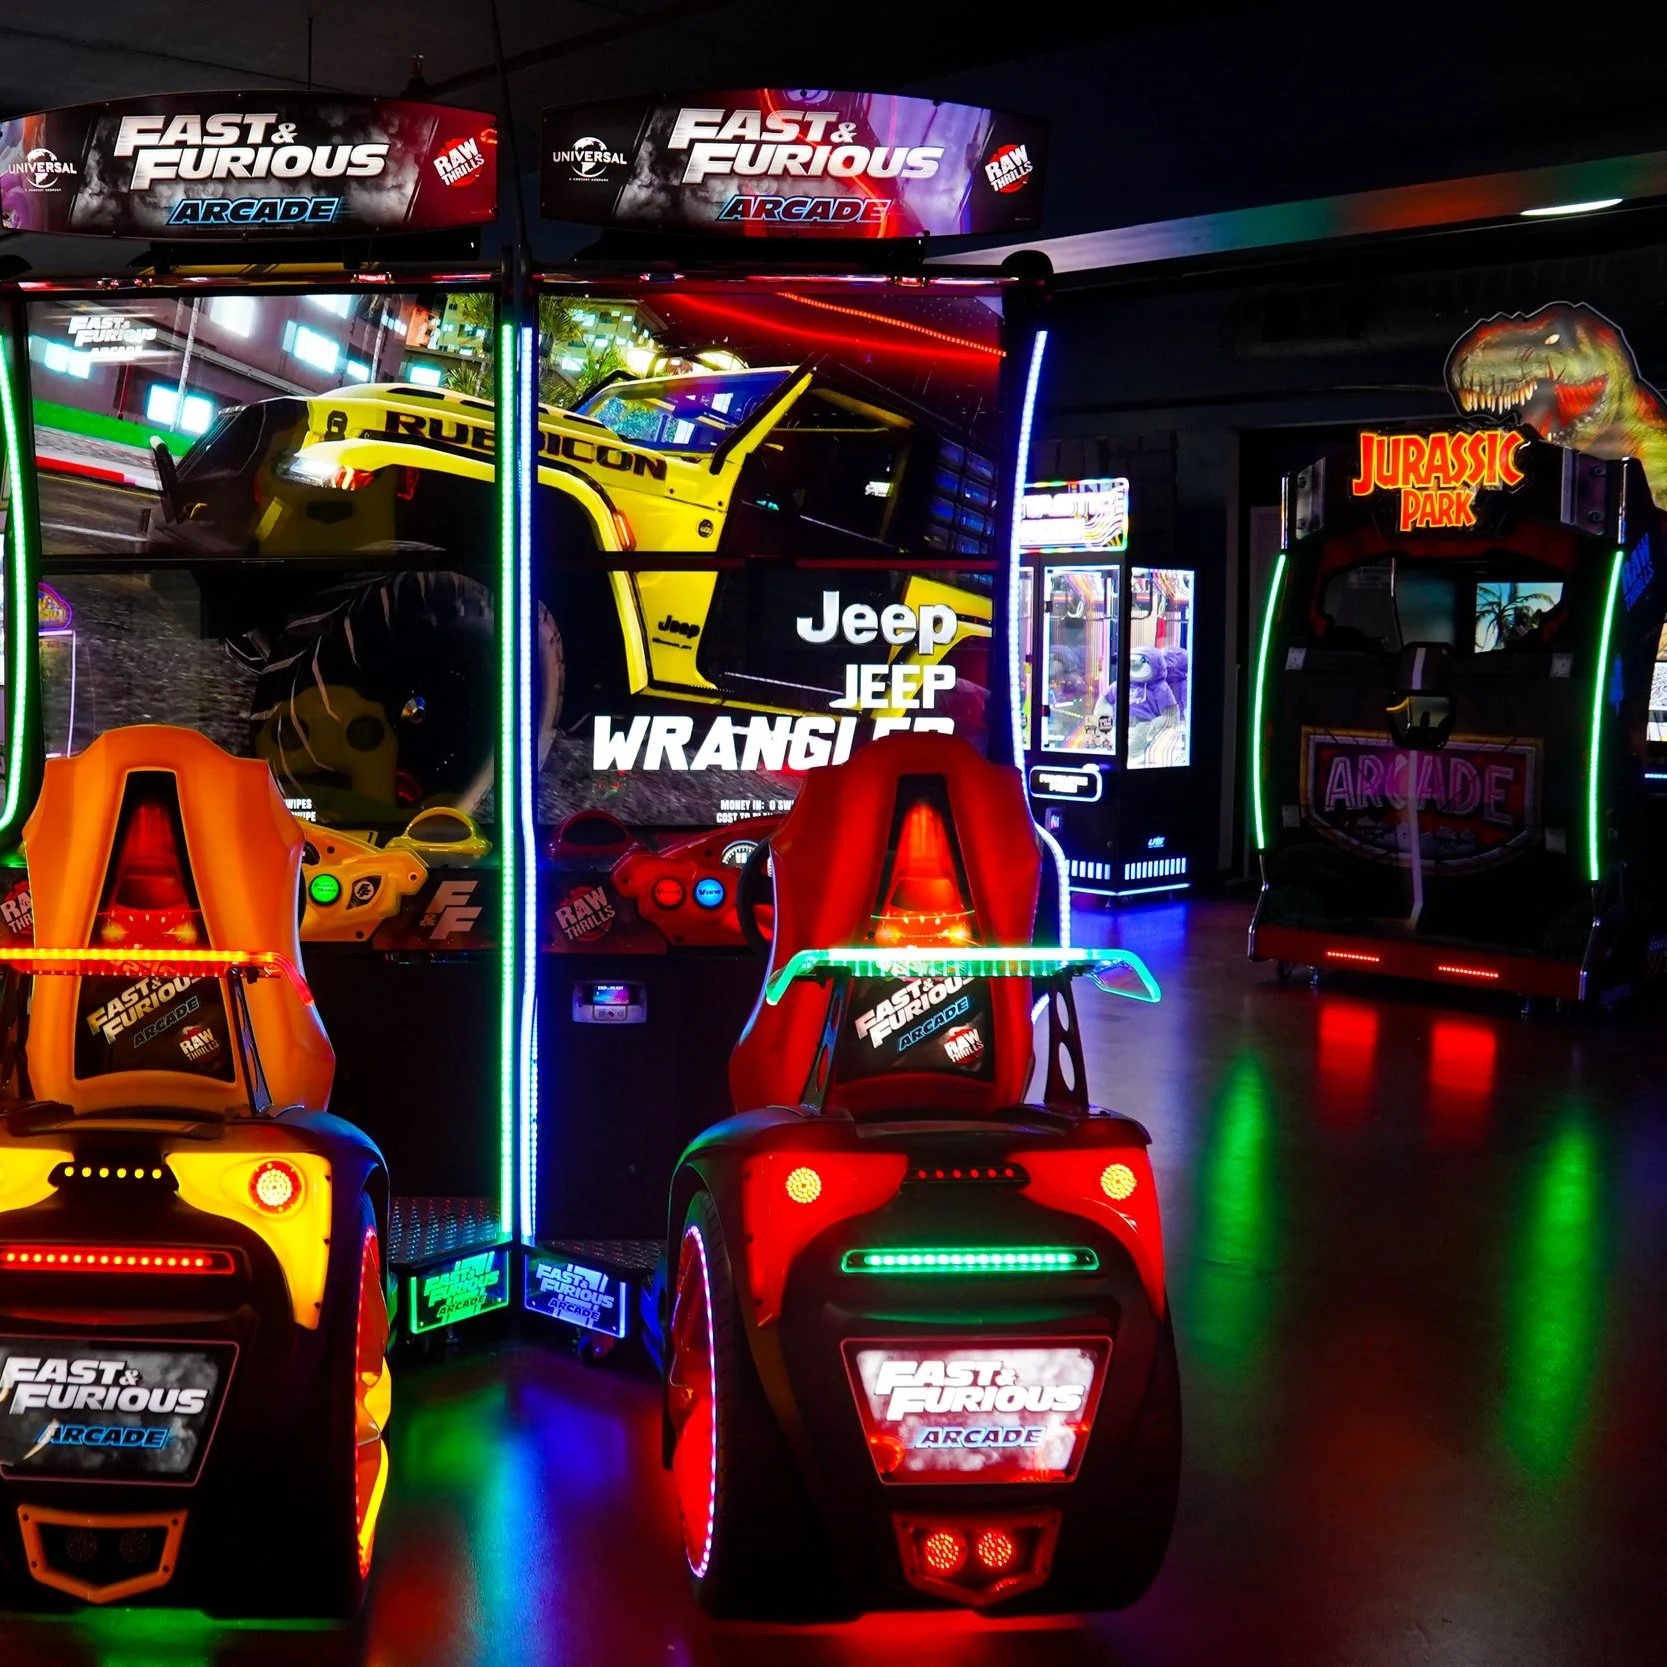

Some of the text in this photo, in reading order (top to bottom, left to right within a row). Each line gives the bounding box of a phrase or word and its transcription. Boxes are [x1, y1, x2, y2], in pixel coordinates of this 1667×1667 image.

[114, 114, 278, 157] FAST
[667, 108, 838, 149] FAST
[8, 161, 78, 175] UNIVERSAL
[130, 143, 391, 191] FURIOUS
[433, 138, 478, 176] RAW
[441, 154, 486, 188] THRILLS
[553, 150, 628, 165] UNIVERSAL
[681, 143, 944, 184] FURIOUS
[983, 143, 1028, 182] RAW
[990, 159, 1034, 193] THRILLS
[168, 197, 343, 225] ARCADE
[718, 195, 893, 223] ARCADE
[74, 328, 157, 347] FURIOUS
[1351, 429, 1525, 497] JURASSIC
[1399, 489, 1478, 532] PARK
[658, 614, 700, 639] Jeep
[797, 591, 958, 656] Jeep
[829, 664, 956, 709] JEEP
[285, 798, 312, 809] WIPES
[716, 812, 738, 823] COST
[720, 799, 750, 811] MONEY
[752, 799, 765, 811] IN:
[0, 891, 32, 923] RA
[555, 886, 608, 930] RAW
[564, 905, 616, 941] THRILLS
[86, 977, 150, 1036] FAST
[133, 995, 200, 1048] ARCADE
[855, 979, 922, 1040] FAST
[899, 995, 970, 1052] ARCADE
[179, 1028, 215, 1055] RAW
[187, 1040, 220, 1062] THRILLS
[944, 1028, 981, 1057] RAW
[424, 1267, 470, 1297] FAST
[428, 1270, 500, 1307] FURIOUS
[536, 1264, 581, 1286] FAST
[436, 1295, 487, 1318] ARCADE
[540, 1280, 614, 1309] FURIOUS
[548, 1298, 600, 1321] ARCADE
[0, 1357, 125, 1389] FAST
[875, 1360, 1004, 1396] FAST
[9, 1383, 208, 1415] FURIOUS
[886, 1385, 1085, 1421] FURIOUS
[37, 1423, 171, 1450] ARCADE
[914, 1426, 1048, 1449] ARCADE
